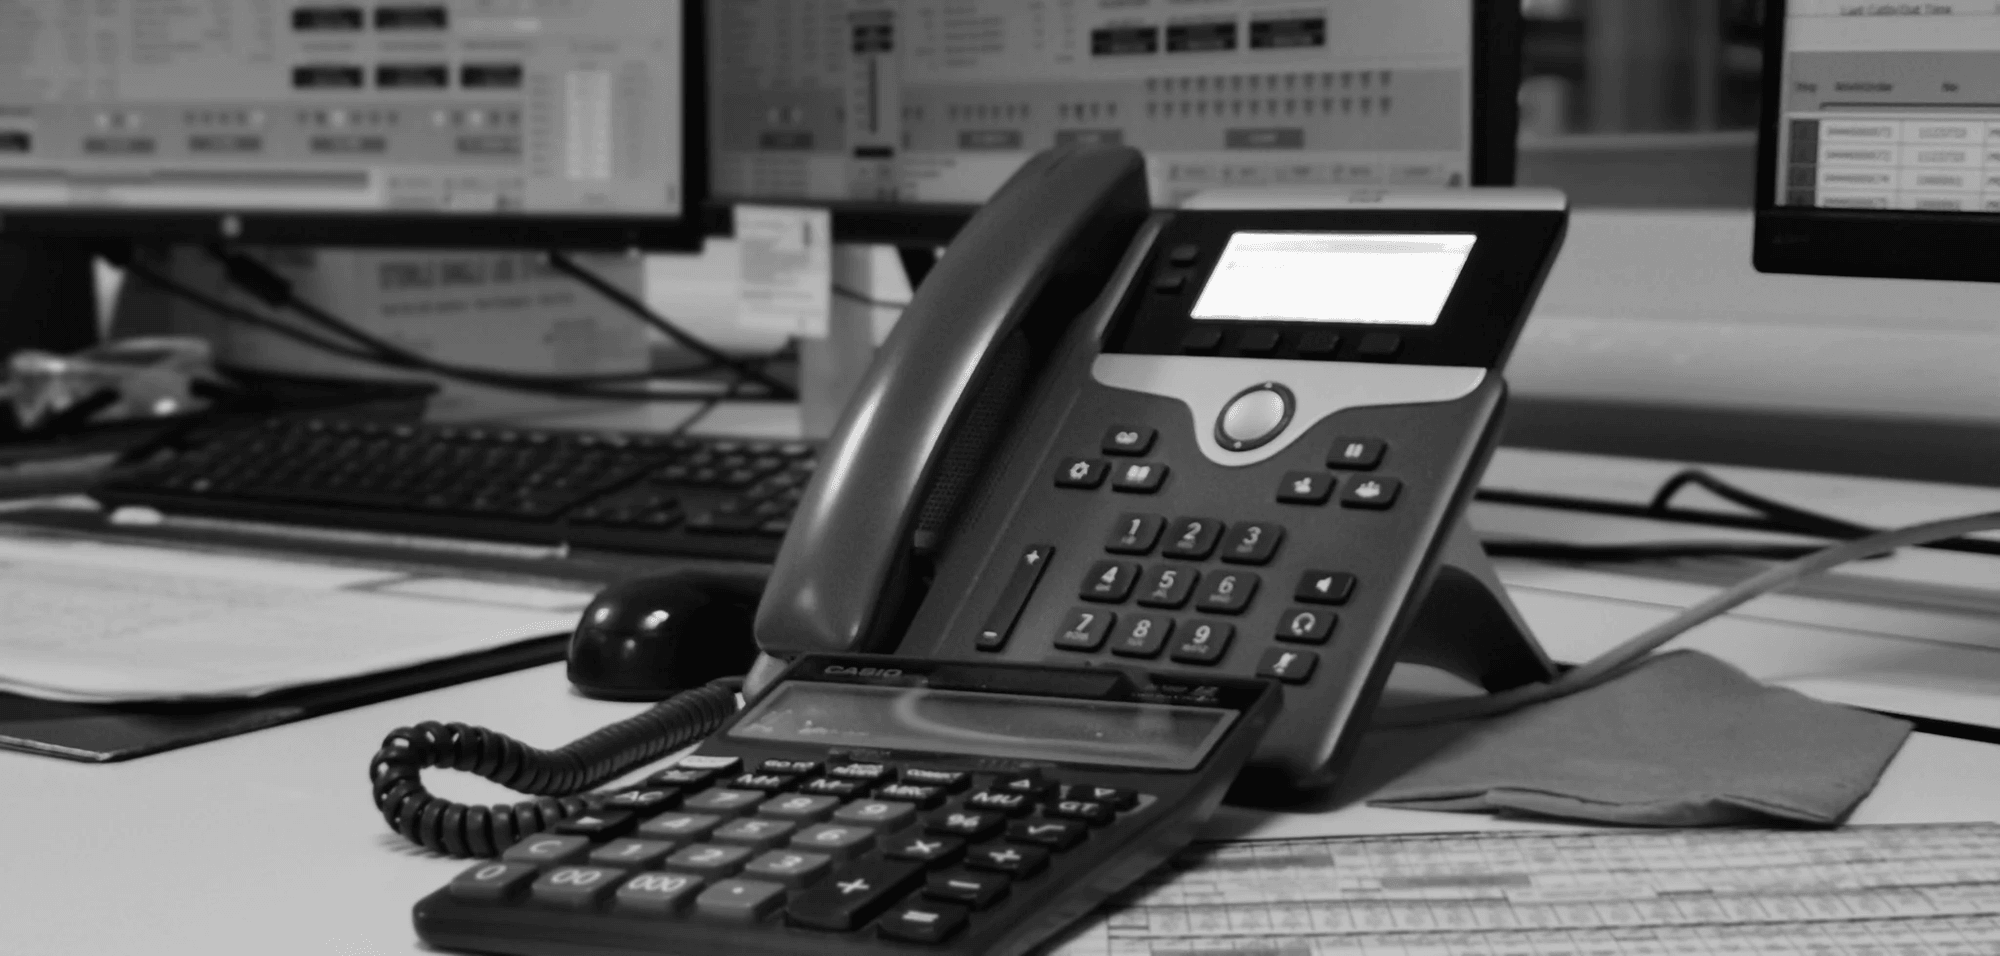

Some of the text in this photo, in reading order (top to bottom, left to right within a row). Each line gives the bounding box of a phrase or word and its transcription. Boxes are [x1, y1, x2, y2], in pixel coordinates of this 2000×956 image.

[1129, 518, 1142, 536] 1
[1184, 523, 1201, 540] 2
[1244, 527, 1261, 545] 3
[1102, 567, 1118, 583] 4
[1160, 571, 1176, 588] 5
[1219, 577, 1235, 593] 6
[1077, 614, 1093, 631] 7
[1133, 620, 1151, 637] 8
[1194, 626, 1210, 643] 9
[825, 665, 903, 677] CASIO
[613, 790, 663, 802] AC
[715, 793, 739, 802] 7
[973, 792, 1022, 803] MU
[783, 798, 812, 809] 8
[860, 804, 887, 814] 9
[1059, 802, 1096, 811] GT
[662, 818, 692, 828] 4
[949, 814, 979, 827] %
[738, 822, 767, 833] 5
[817, 829, 846, 840] 6
[530, 841, 561, 853] C
[620, 844, 642, 856] 1
[691, 849, 723, 861] 2
[770, 856, 802, 868] 3
[475, 864, 507, 881] 0
[551, 870, 601, 885] 00
[629, 876, 686, 892] 000
